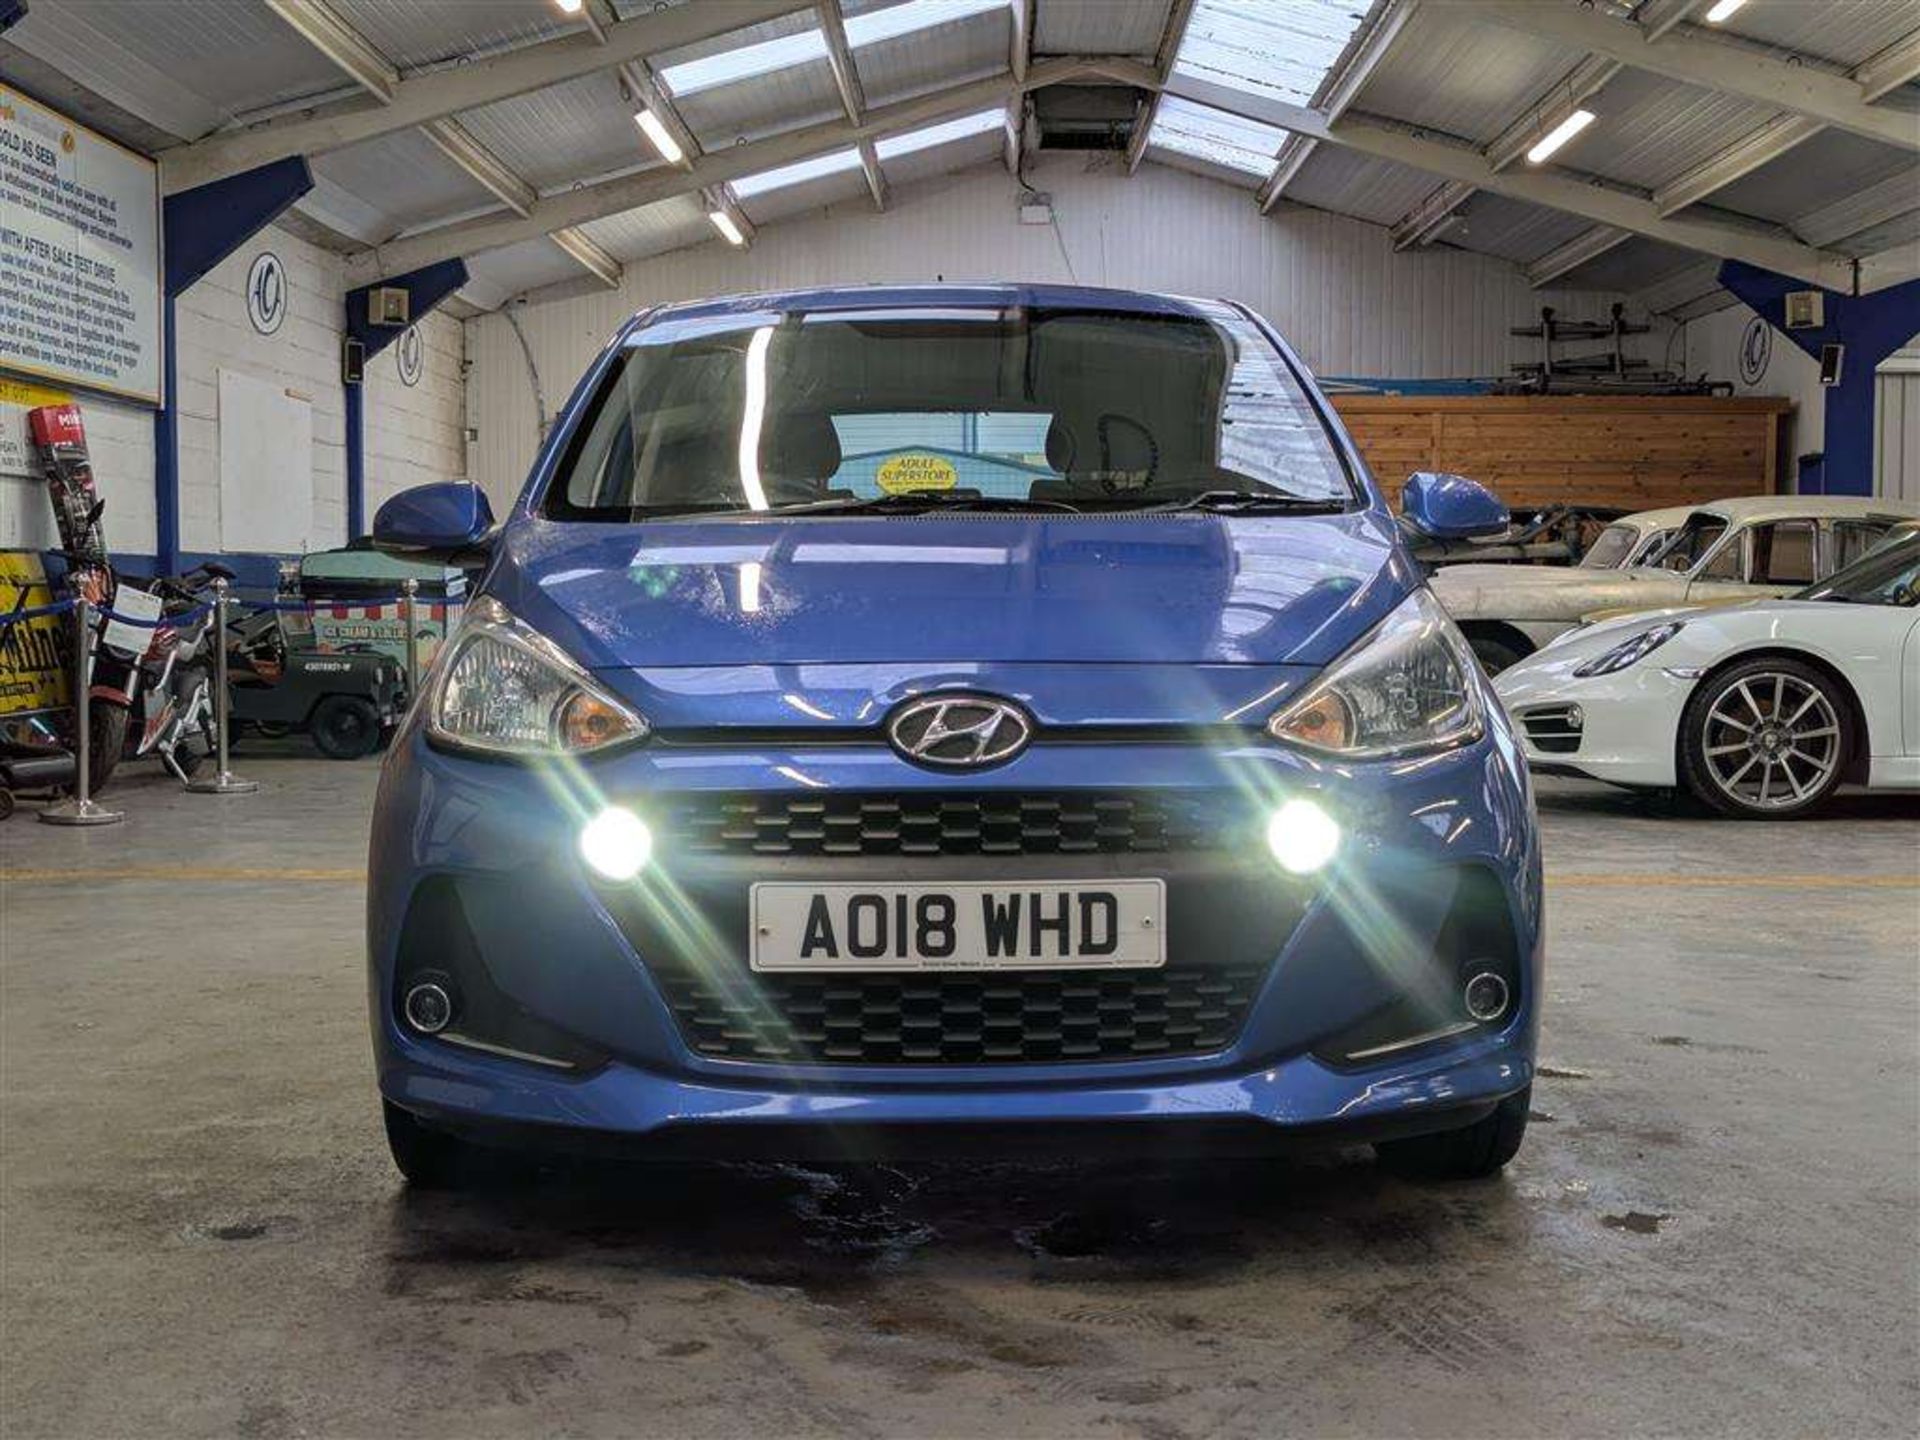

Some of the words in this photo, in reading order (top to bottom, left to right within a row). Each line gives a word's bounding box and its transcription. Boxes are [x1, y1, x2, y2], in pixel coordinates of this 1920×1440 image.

[22, 139, 33, 158] AS
[35, 144, 56, 169] SEEN
[1, 228, 22, 249] WITH
[25, 237, 50, 260] AFTER
[52, 246, 72, 268] SALE
[74, 254, 92, 274] TEST
[94, 262, 115, 283] DRIVE
[981, 891, 1119, 957] WHD
